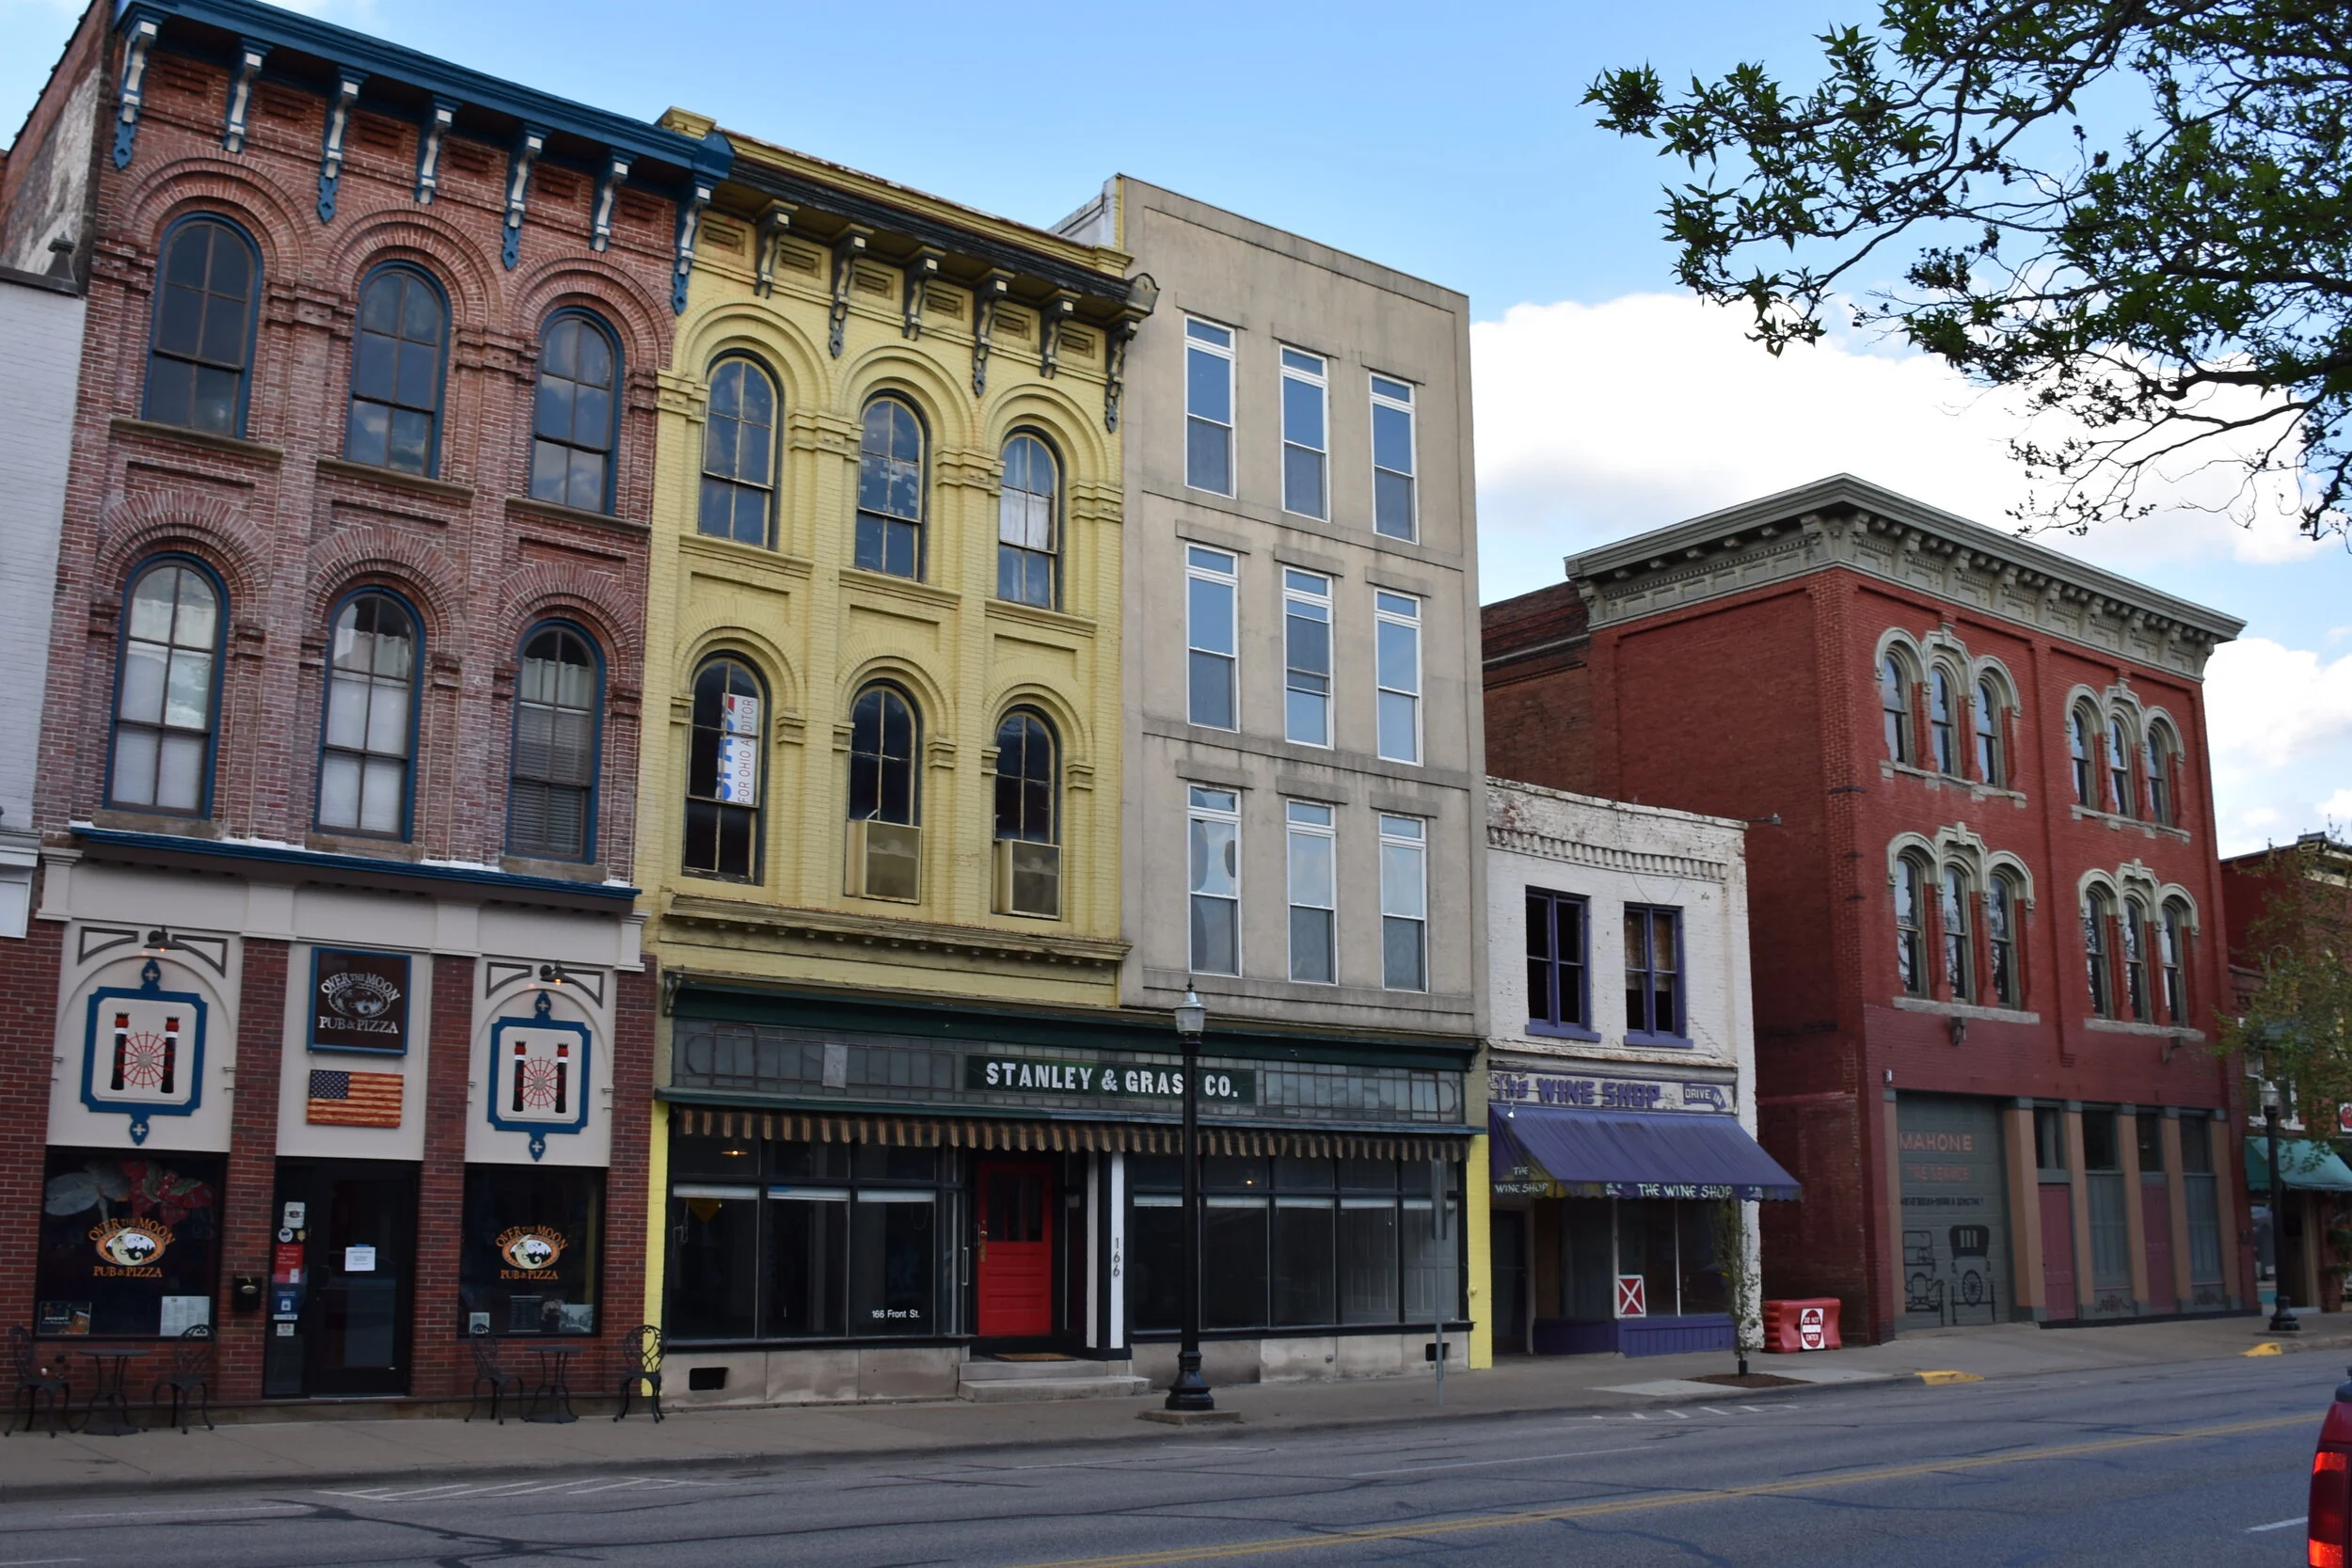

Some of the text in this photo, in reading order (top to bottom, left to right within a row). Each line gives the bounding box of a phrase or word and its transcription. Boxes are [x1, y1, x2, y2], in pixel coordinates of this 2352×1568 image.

[739, 751, 752, 777] OHIO
[738, 782, 750, 803] FOR
[321, 973, 352, 994] OVER
[365, 973, 401, 1002] MOON
[319, 1016, 346, 1030] PUB
[357, 1019, 399, 1034] PIZZA
[986, 1062, 1239, 1098] STANLEY & GRAS CO.
[1536, 1077, 1596, 1105] WINE
[1602, 1083, 1661, 1107] SHOP
[1685, 1087, 1724, 1105] DRIVE IN
[1899, 1132, 1973, 1152] MAHONE
[1513, 1166, 1529, 1176] THE
[1495, 1182, 1549, 1194] WINE SHOP
[1637, 1183, 1733, 1199] THE WINE SHOP
[88, 1218, 120, 1241] OVER
[139, 1217, 176, 1245] MOON
[496, 1227, 522, 1247] OVER
[537, 1225, 568, 1250] MOON
[93, 1266, 119, 1276] PUB
[125, 1267, 163, 1278] PIZZA
[501, 1270, 520, 1279] PUB
[527, 1270, 558, 1280] PIZZA
[872, 1309, 885, 1318] 166
[887, 1309, 907, 1318] Front
